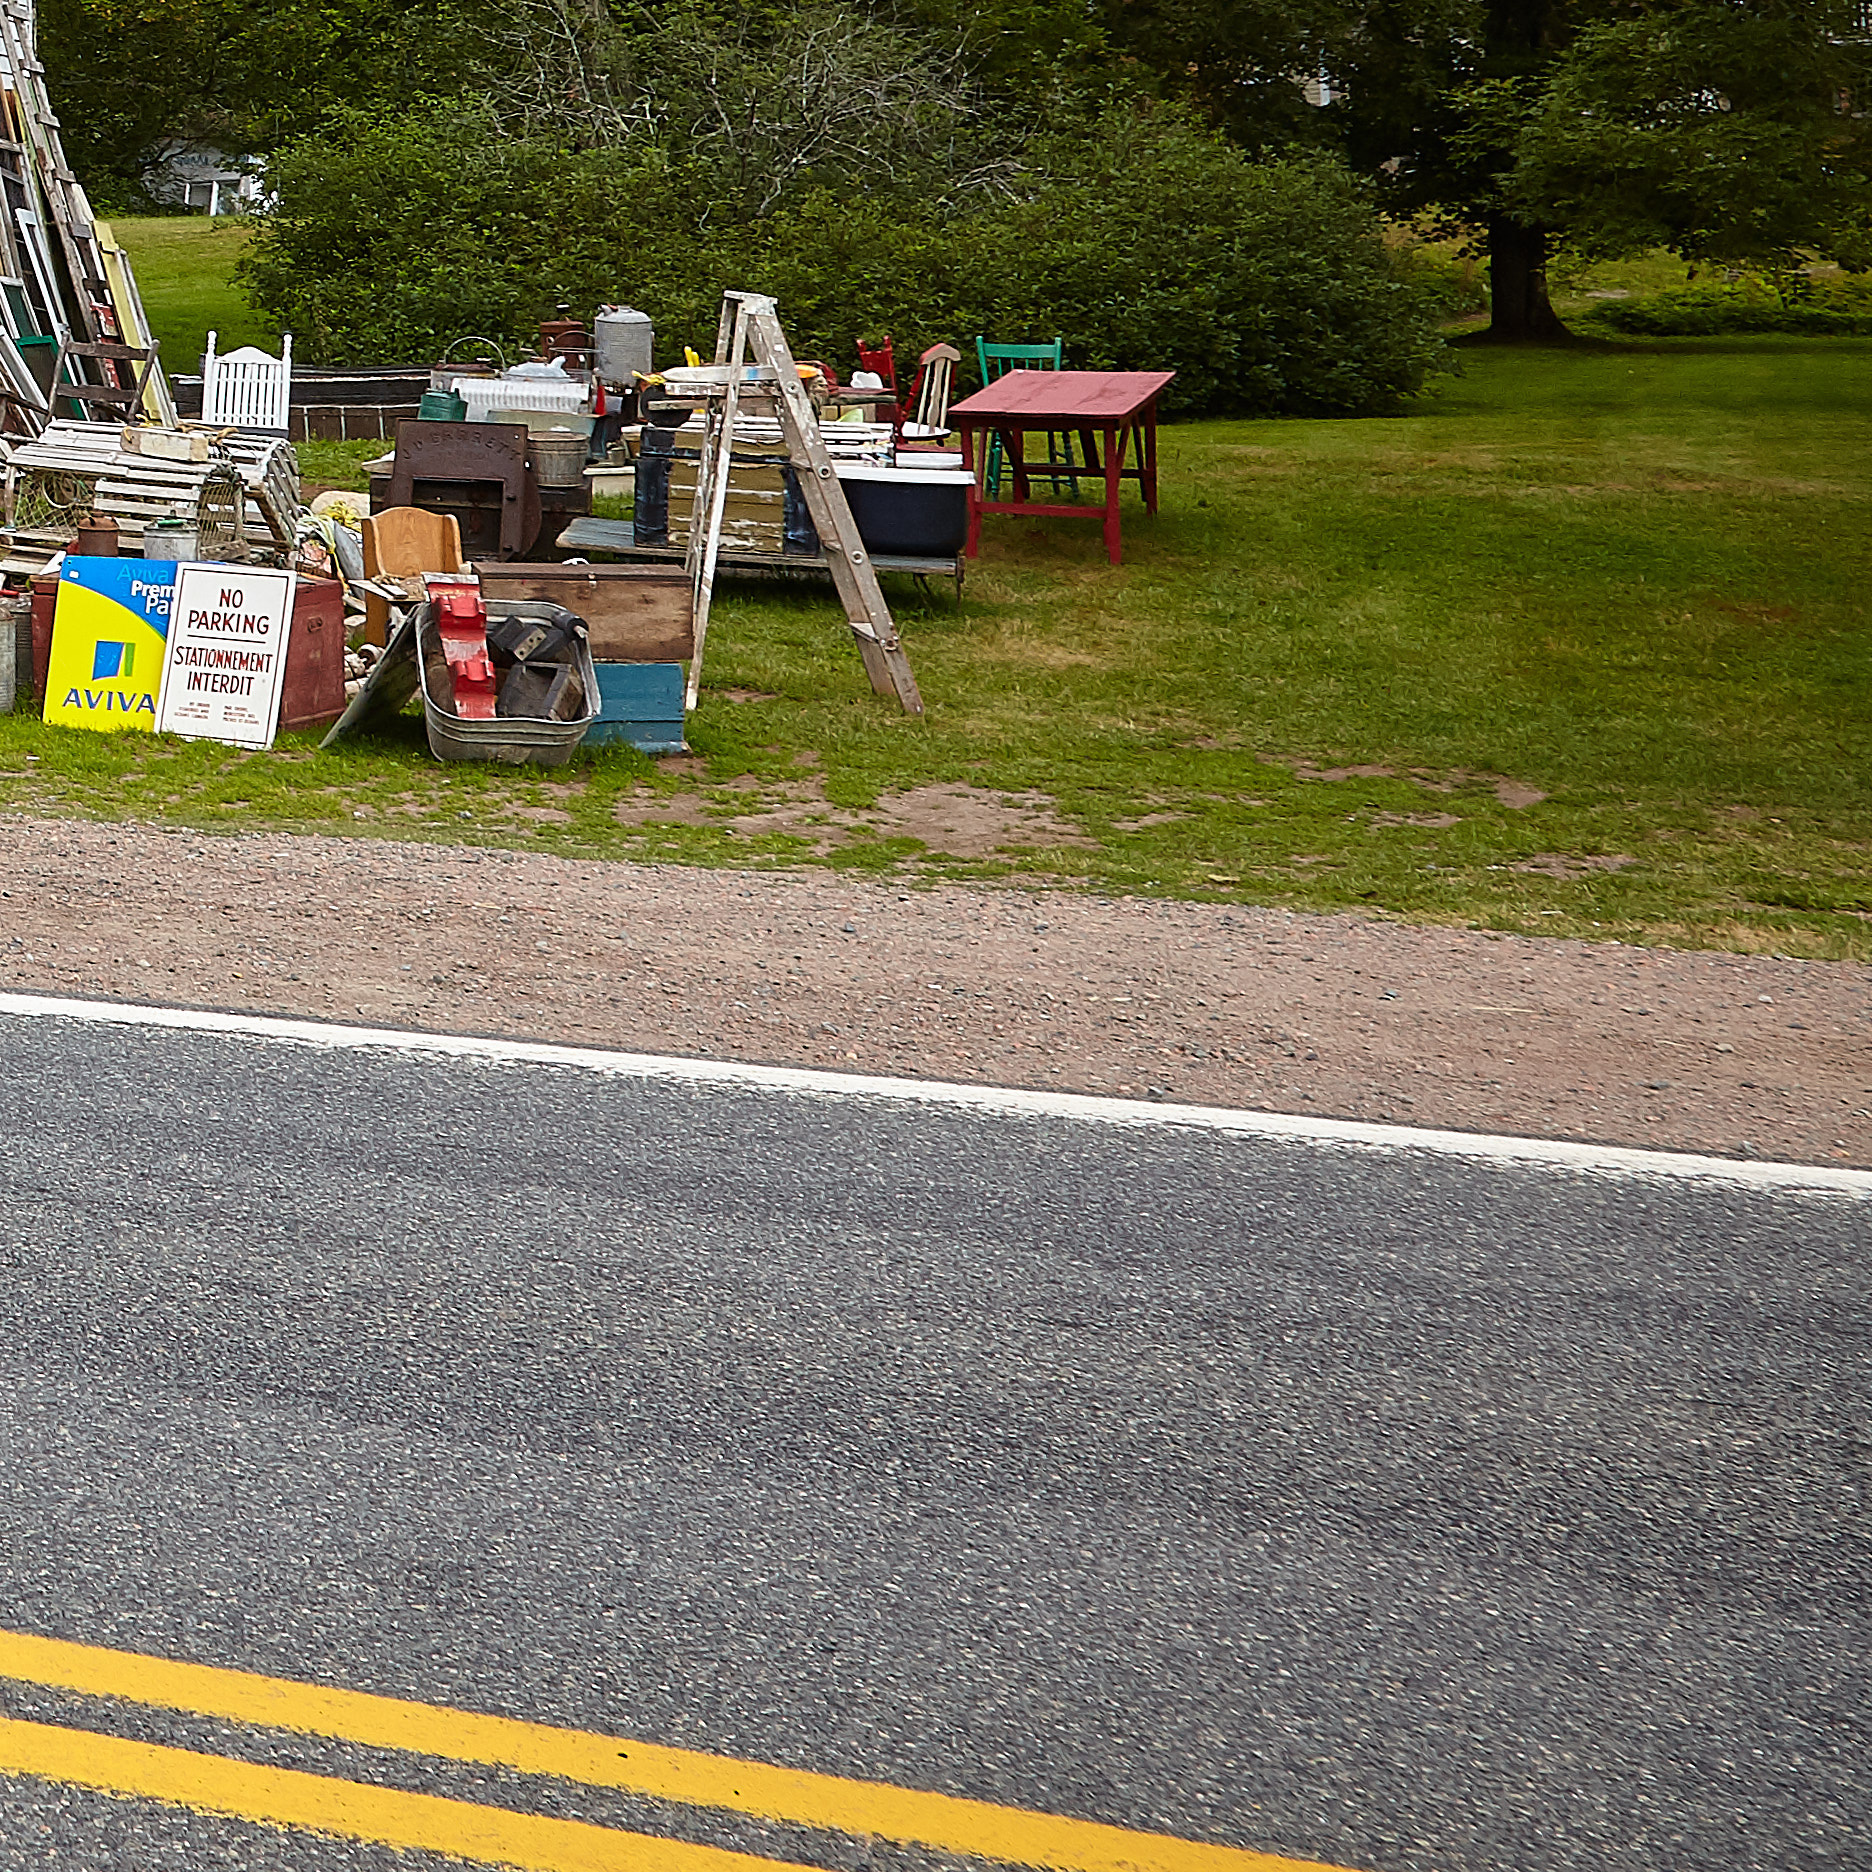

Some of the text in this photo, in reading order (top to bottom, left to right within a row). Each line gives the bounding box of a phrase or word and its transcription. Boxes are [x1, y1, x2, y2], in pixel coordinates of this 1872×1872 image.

[116, 563, 170, 584] Aviva
[218, 588, 244, 608] NO
[187, 610, 270, 635] PARKING
[173, 645, 274, 674] STATIONNEMENT
[186, 671, 255, 696] INTERDIT
[62, 687, 156, 715] AVIVA
